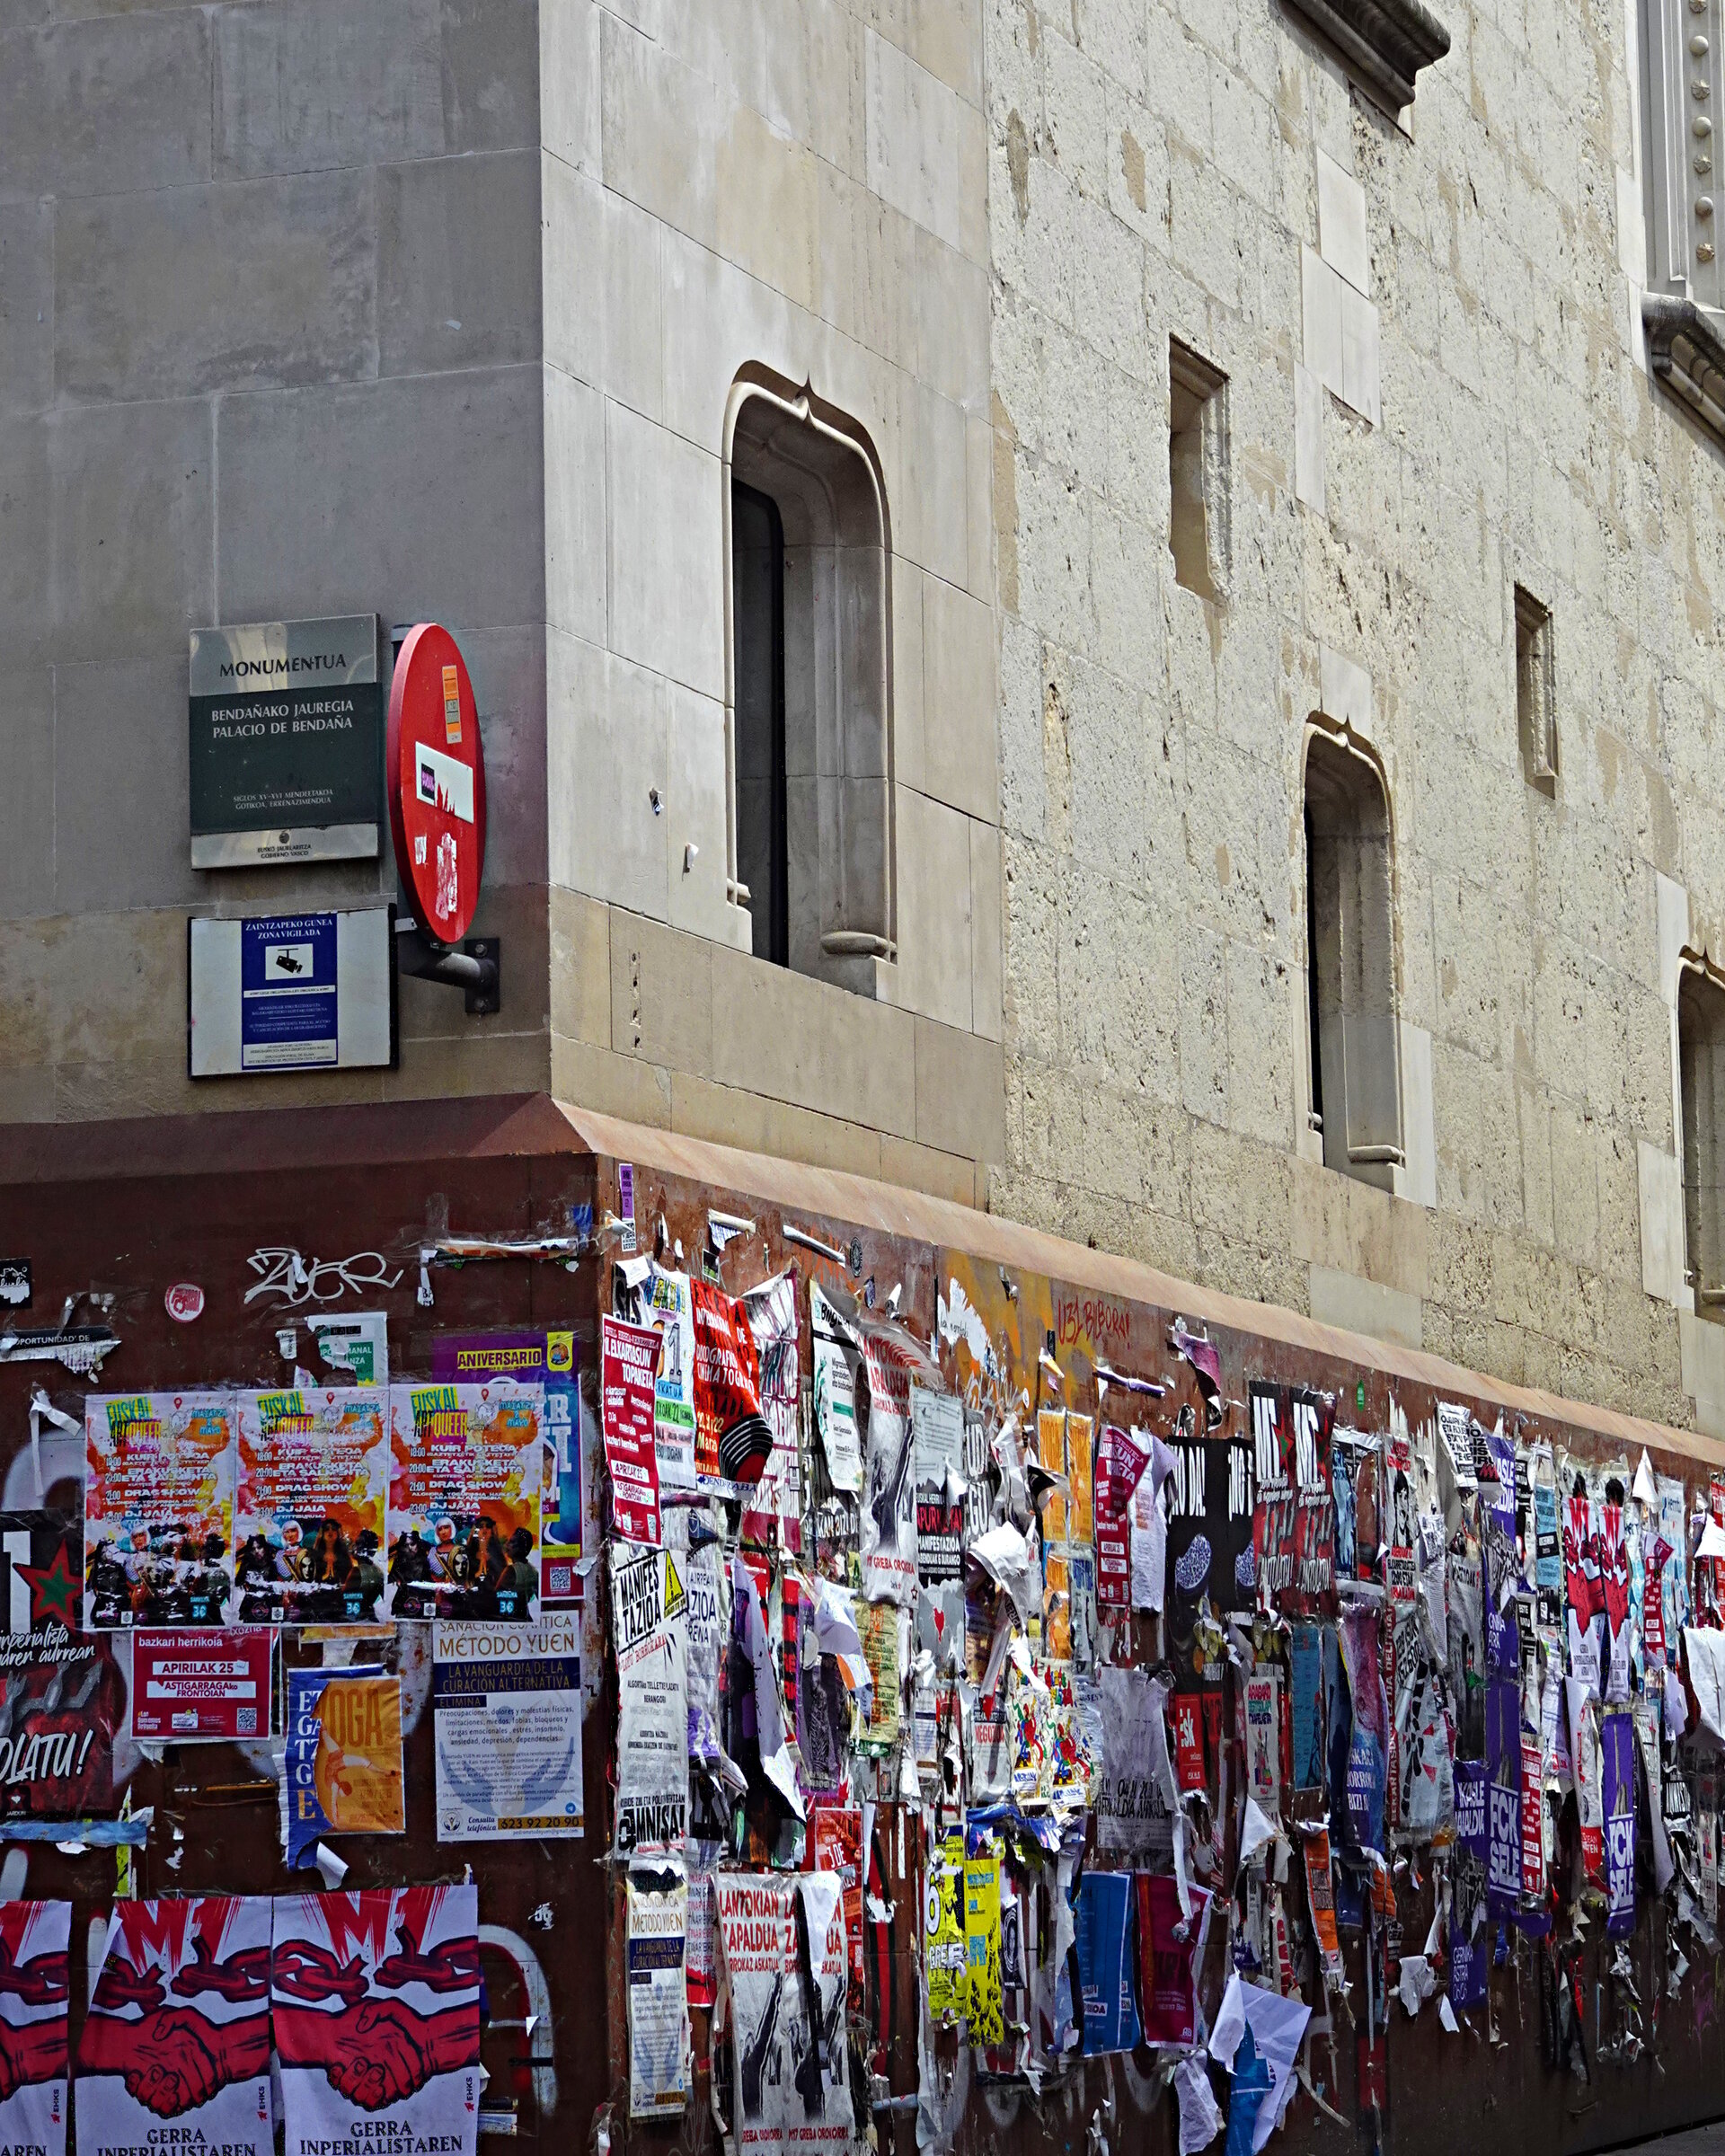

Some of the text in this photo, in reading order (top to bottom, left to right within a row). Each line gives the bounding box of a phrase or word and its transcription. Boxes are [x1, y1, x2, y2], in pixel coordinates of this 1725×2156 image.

[220, 654, 346, 676] MONUMENTUA
[212, 700, 353, 721] BENDAÑAKO JAUREGIA
[213, 715, 352, 738] PALACIO DE BENDAÑA
[245, 921, 303, 931] ZAINTZAPEKO
[458, 1351, 541, 1367] ANIVERSARIO
[623, 1363, 654, 1391] TOPAKETA
[411, 1386, 458, 1420] EUSKAL
[106, 1396, 150, 1427] EUSKAL
[414, 1410, 467, 1437] ART QUEER
[507, 1418, 528, 1427] MAYO
[409, 1464, 427, 1473] 20:00
[410, 1482, 426, 1491] 21:00
[918, 1535, 960, 1551] MANIFESTAZIOA
[620, 1557, 659, 1608] MANIFES
[346, 1602, 360, 1615] 3€
[500, 1601, 515, 1614] 3€
[623, 1592, 661, 1642] TAZIOA
[139, 1637, 223, 1647] bazkari herrikoia
[439, 1633, 575, 1657] MÉTODO YUEN
[39, 1645, 95, 1663] aurrean
[163, 1663, 234, 1673] APIRILAK 25
[449, 1661, 563, 1678] LA VANGUARDIA DE LA
[164, 1682, 238, 1690] ASTIGARRAGAko
[443, 1675, 570, 1692] CURACIÓN ALTERNATIVA
[440, 1696, 481, 1707] ELIMINA
[535, 1717, 563, 1725] bloqueos
[501, 1816, 579, 1829] 623 92 20 90
[1490, 1789, 1518, 1846] FCK
[467, 1825, 496, 1833] telefónica
[719, 1889, 779, 1918] LANTOKIAN
[755, 1957, 779, 1972] ASKATUA
[146, 2128, 206, 2144] GERRA
[350, 2121, 413, 2137] GERRA
[800, 2127, 817, 2141] GREBA
[300, 2135, 463, 2156] INPERIALISTAREN
